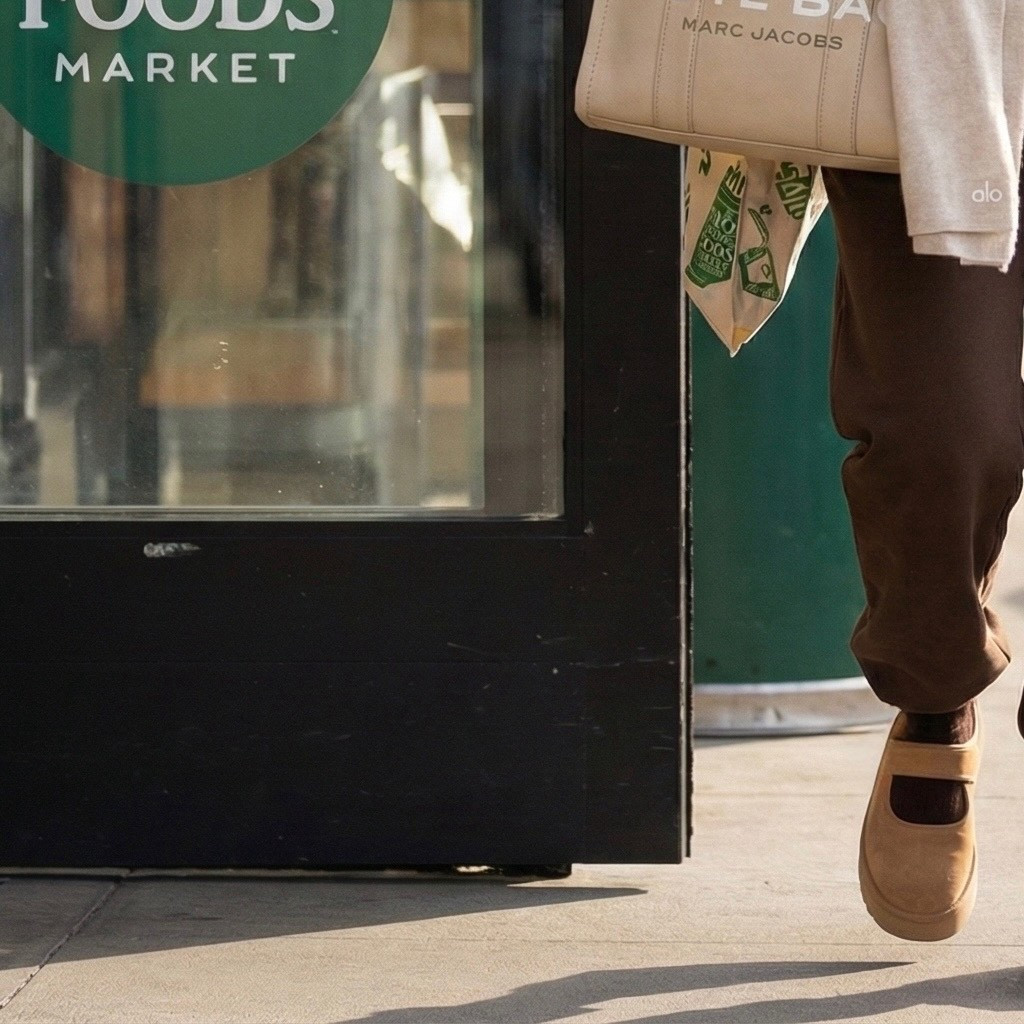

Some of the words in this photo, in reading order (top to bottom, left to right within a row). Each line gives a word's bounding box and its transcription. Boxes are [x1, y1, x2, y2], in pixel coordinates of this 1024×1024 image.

[682, 17, 743, 38] MARC
[751, 27, 843, 50] JACOBS
[54, 52, 296, 84] MARKET
[971, 180, 1003, 203] alo
